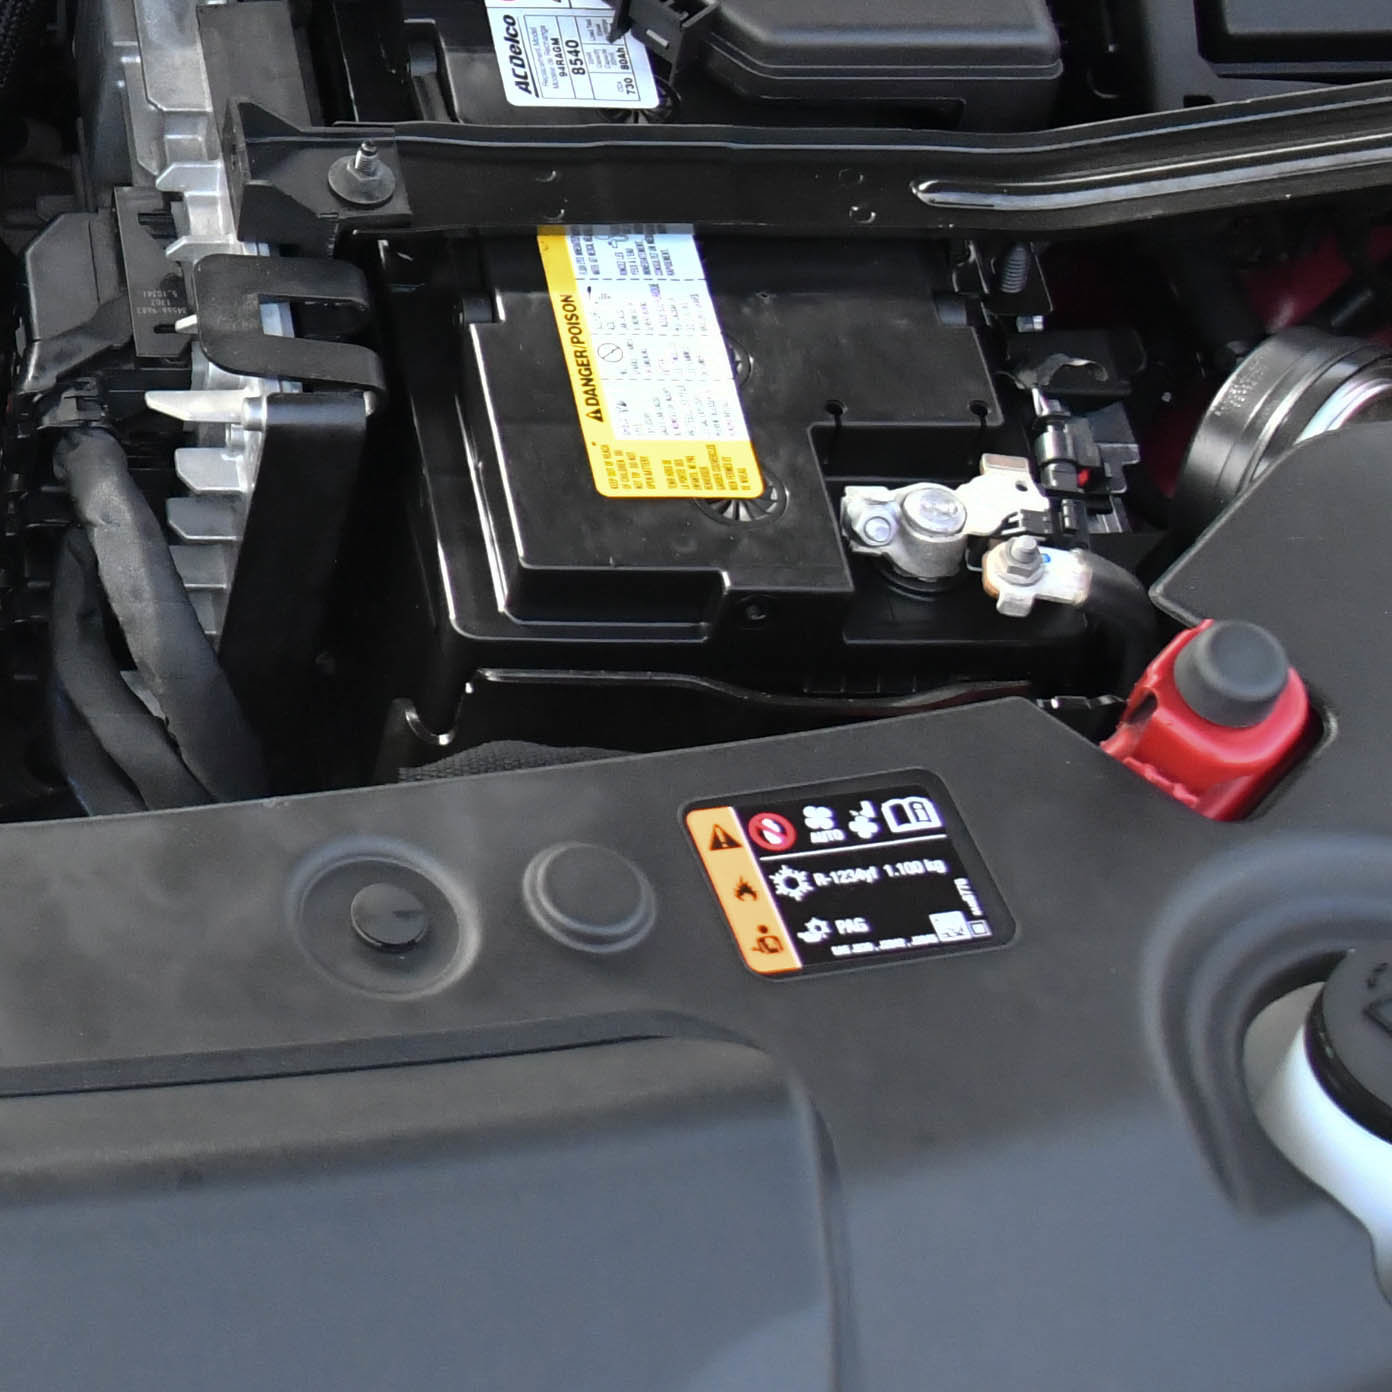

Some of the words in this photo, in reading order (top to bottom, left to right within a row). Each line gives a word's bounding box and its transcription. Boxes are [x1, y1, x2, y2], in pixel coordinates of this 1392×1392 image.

[503, 15, 531, 95] ACDelco
[551, 37, 567, 77] 94RAGM
[565, 40, 585, 75] 8540
[616, 47, 629, 70] 80Ah
[624, 78, 635, 94] 730
[562, 294, 598, 407] DANGER/POISON
[810, 828, 846, 844] AUTO
[813, 868, 879, 887] R-1234yf
[835, 917, 870, 935] PAG
